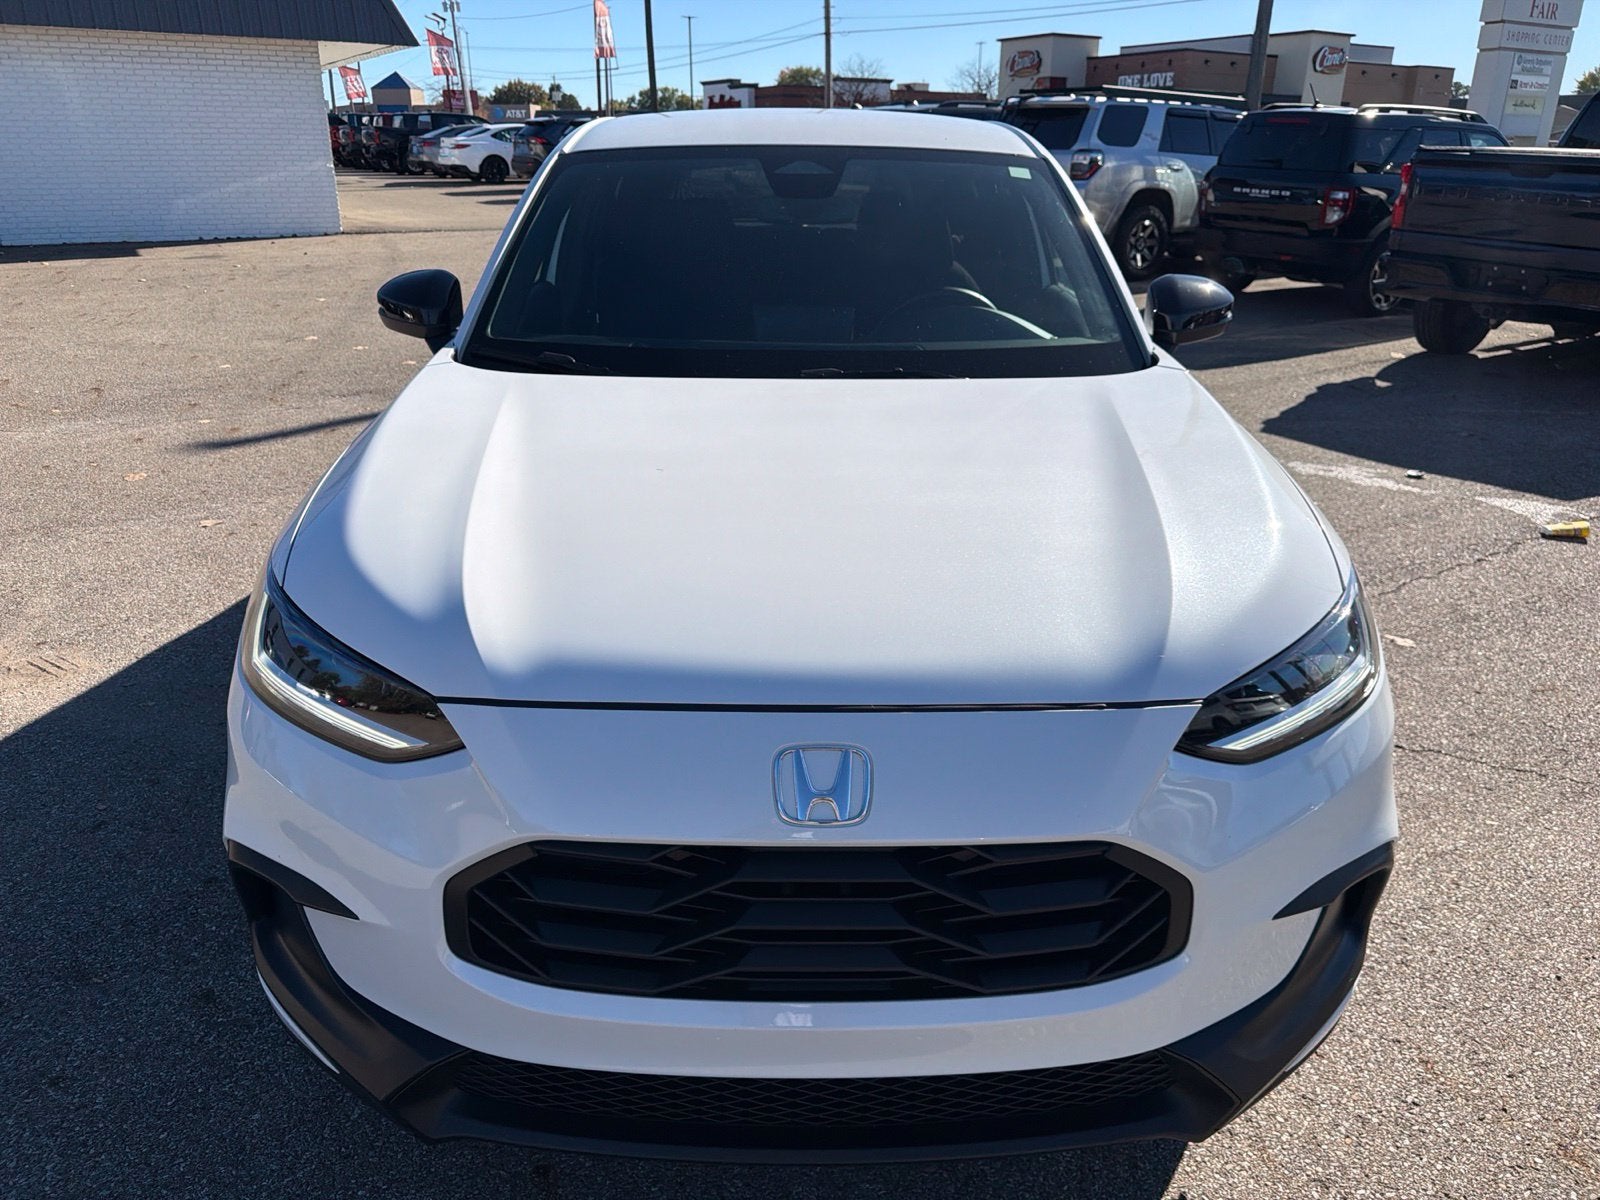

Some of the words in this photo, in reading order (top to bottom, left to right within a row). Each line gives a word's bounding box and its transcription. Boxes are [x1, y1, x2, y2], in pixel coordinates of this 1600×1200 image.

[1529, 0, 1558, 20] FAIR
[1506, 30, 1540, 44] SHOPPING
[1543, 34, 1570, 47] CENTER
[1118, 74, 1141, 88] ONE
[1142, 72, 1175, 88] LOVE
[505, 109, 527, 119] AT&T
[1233, 186, 1291, 197] BRONCO
